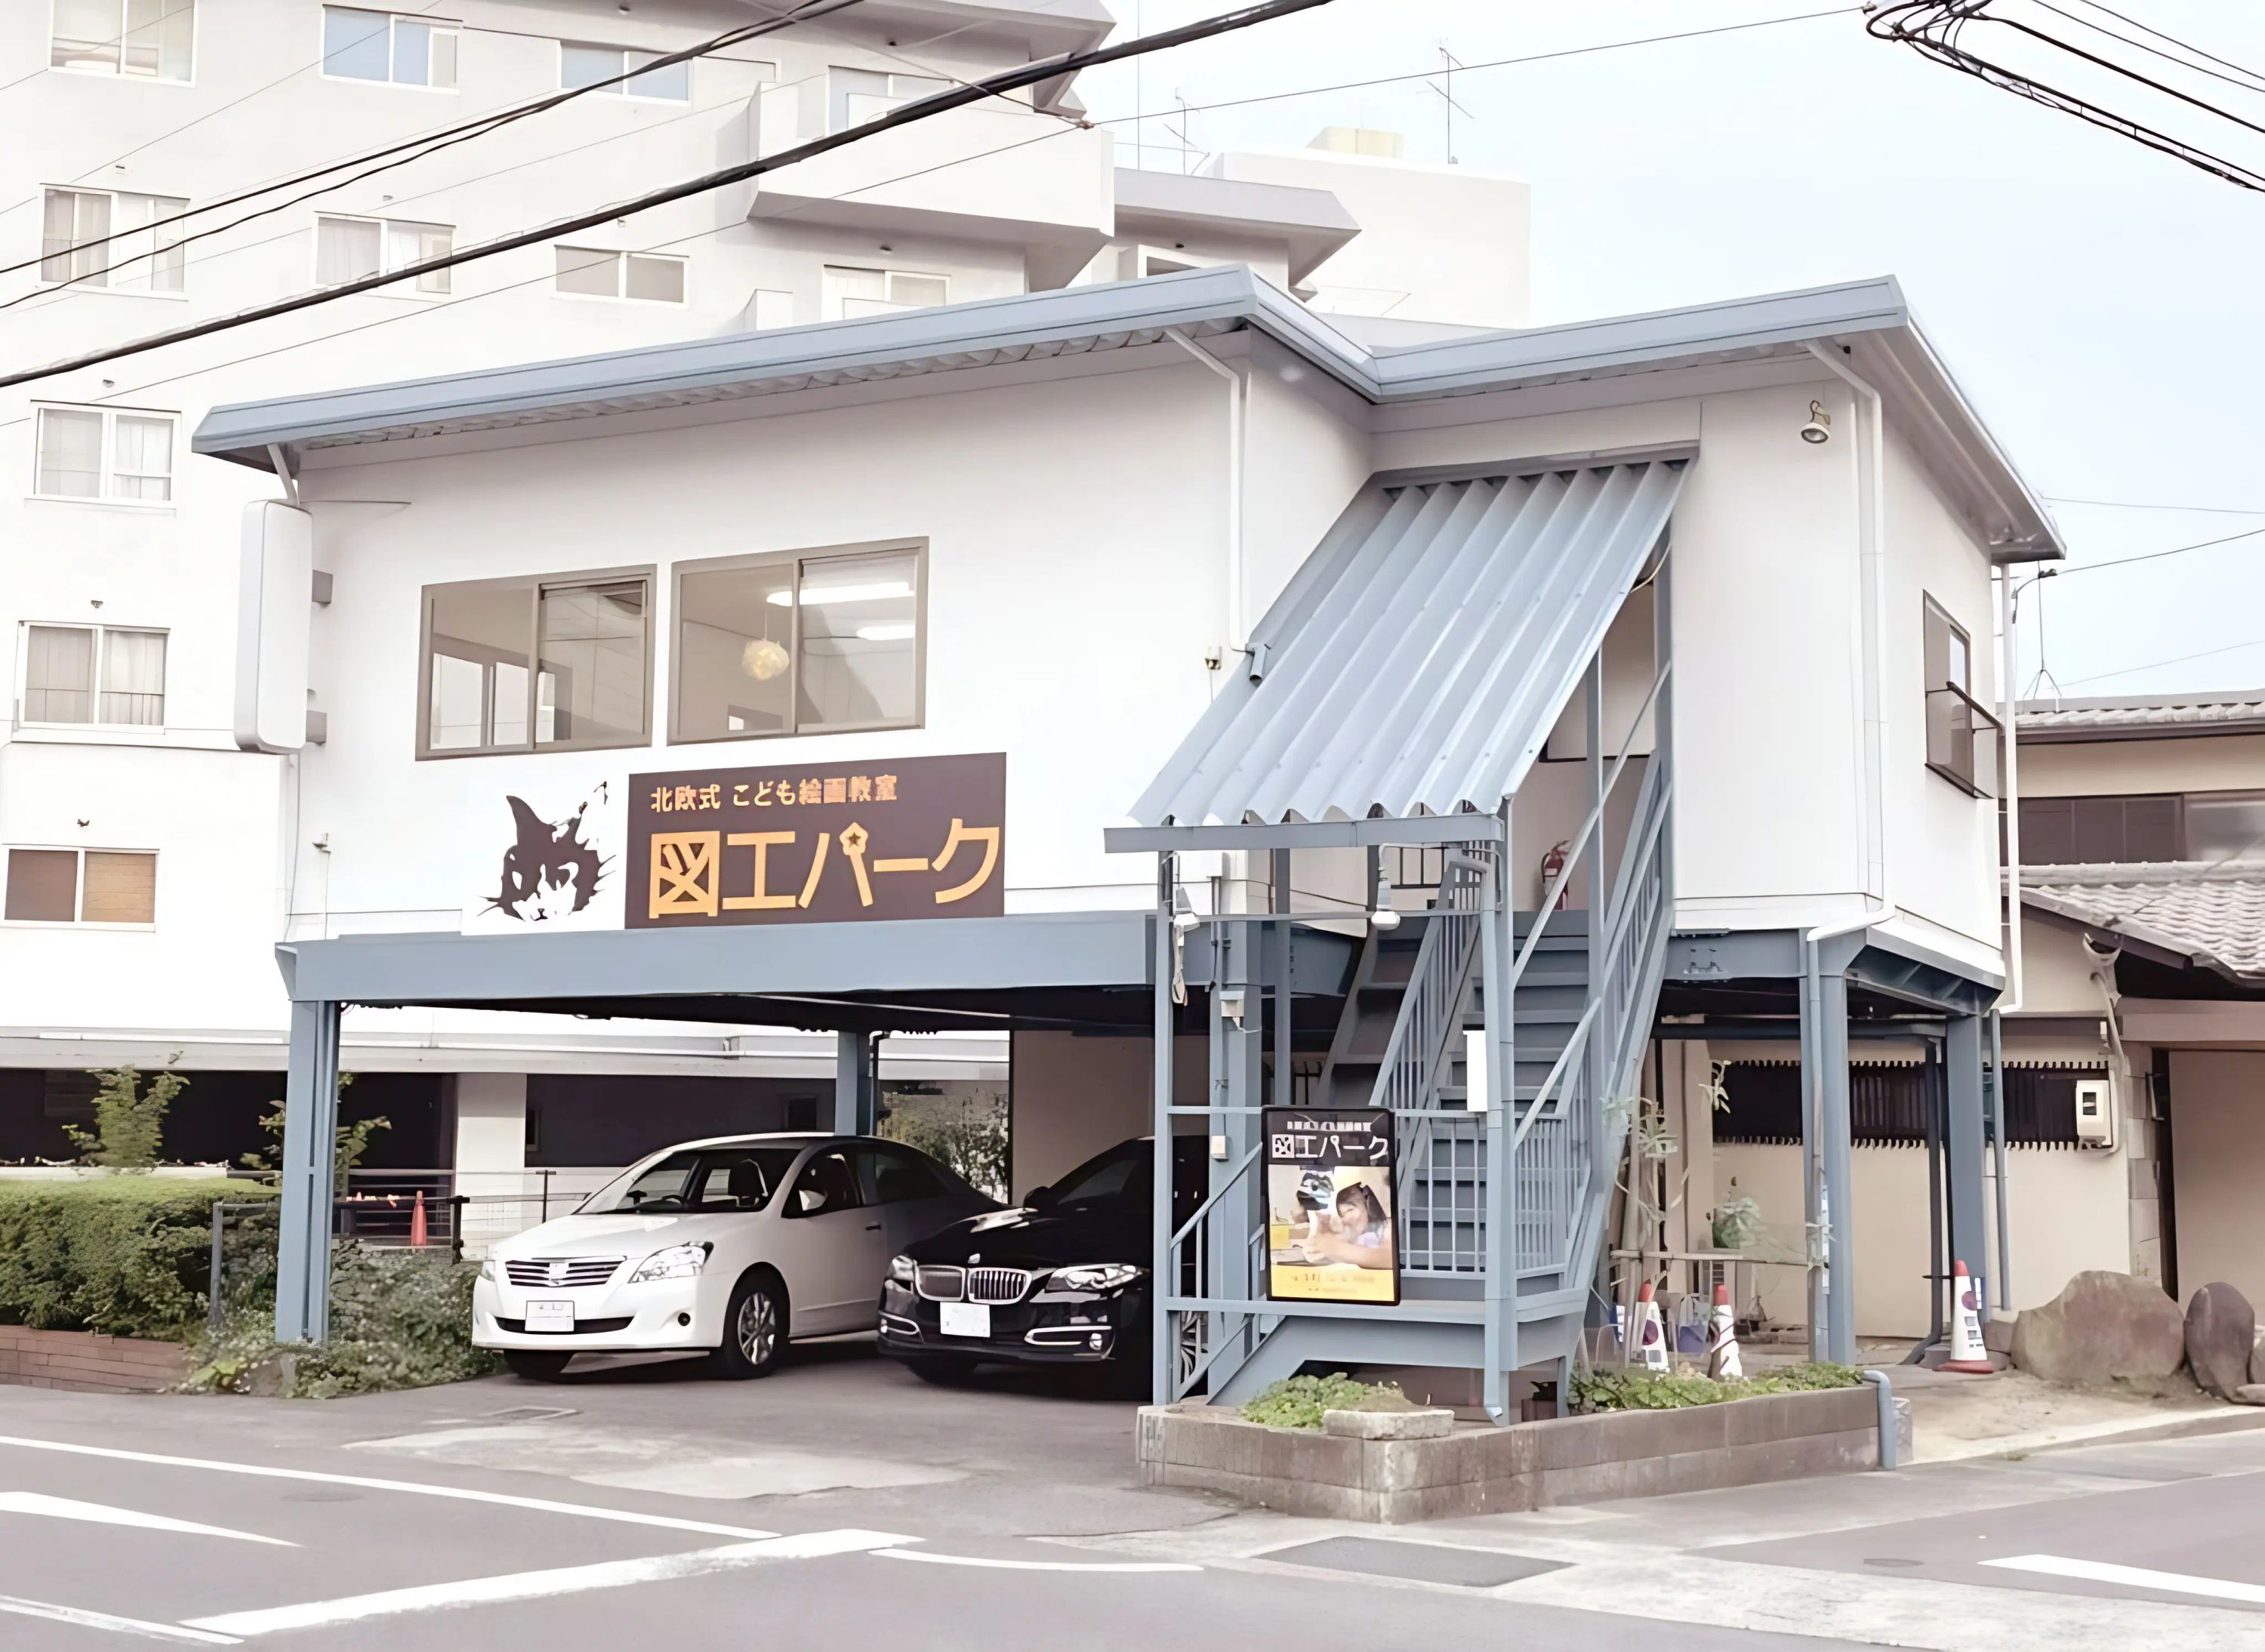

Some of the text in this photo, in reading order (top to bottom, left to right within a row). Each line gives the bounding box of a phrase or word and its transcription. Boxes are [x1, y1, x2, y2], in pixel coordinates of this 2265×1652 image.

[651, 784, 721, 812] 北欧式
[649, 818, 1000, 919] 図工パーク
